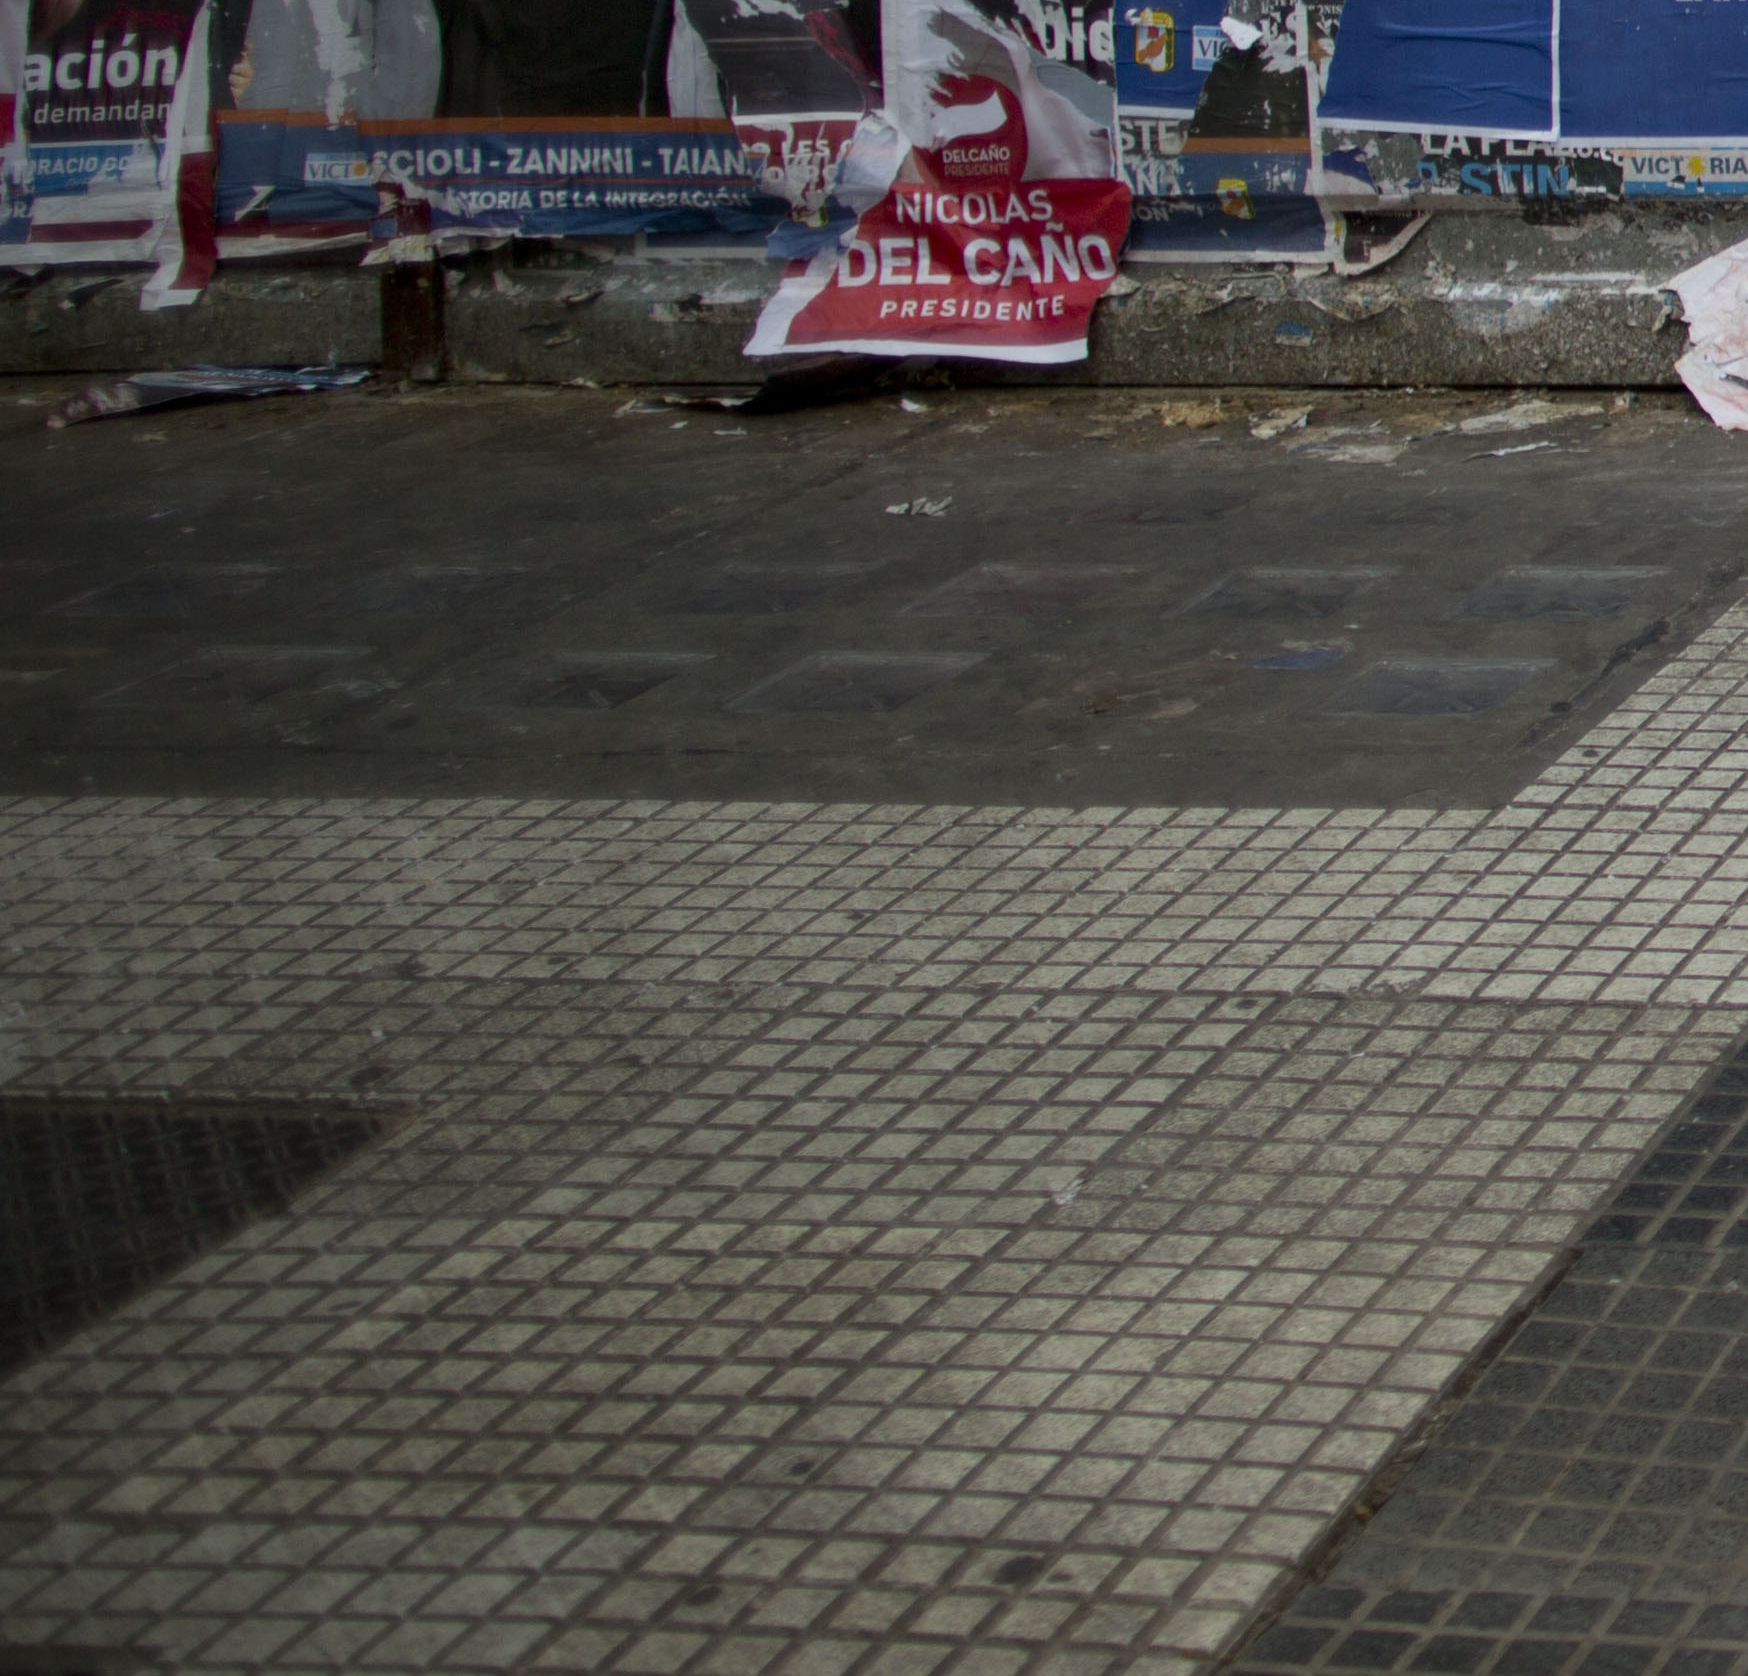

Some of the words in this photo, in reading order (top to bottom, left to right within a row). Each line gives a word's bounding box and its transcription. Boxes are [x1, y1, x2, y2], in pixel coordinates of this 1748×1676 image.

[506, 147, 633, 176] ZANNINI
[942, 144, 1011, 165] DELCAÑO
[540, 190, 568, 209] DE
[896, 186, 1053, 226] NICOLAS
[837, 237, 952, 289] DEL
[962, 222, 1117, 287] CAÑO
[880, 295, 1065, 322] PRESIDENTE
